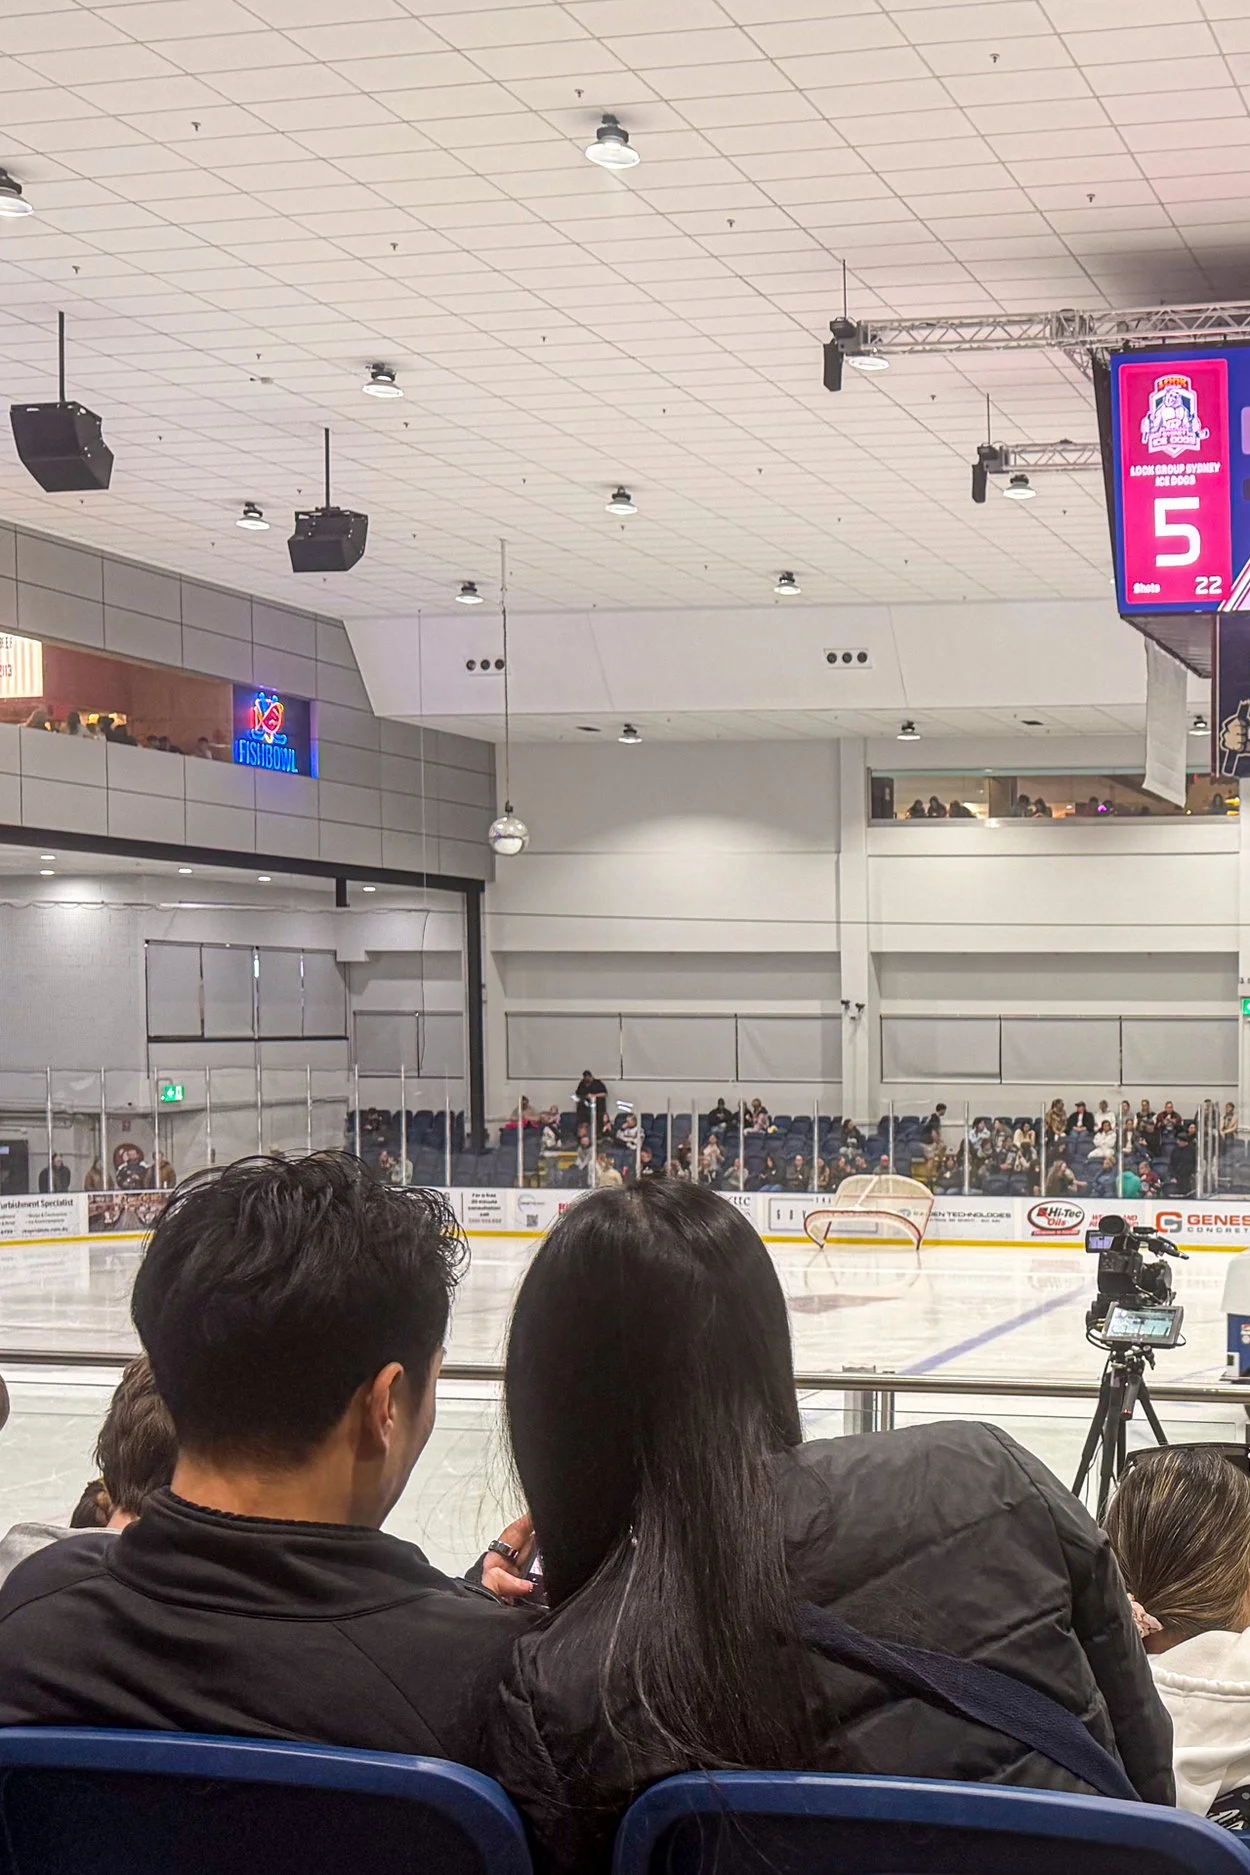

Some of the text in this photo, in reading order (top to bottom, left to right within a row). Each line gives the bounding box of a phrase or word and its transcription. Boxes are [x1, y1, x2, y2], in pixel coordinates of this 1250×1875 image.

[1130, 461, 1221, 477] LOOK GROUP SYDNEY
[1155, 474, 1196, 487] ICE DOGS
[1154, 497, 1201, 567] 5
[1133, 582, 1161, 594] Shots
[1195, 576, 1222, 595] 22
[239, 739, 299, 773] FISHBOWL
[40, 1198, 74, 1209] Specialist
[1048, 1206, 1082, 1218] Hi-Tec
[1047, 1217, 1066, 1226] Oils
